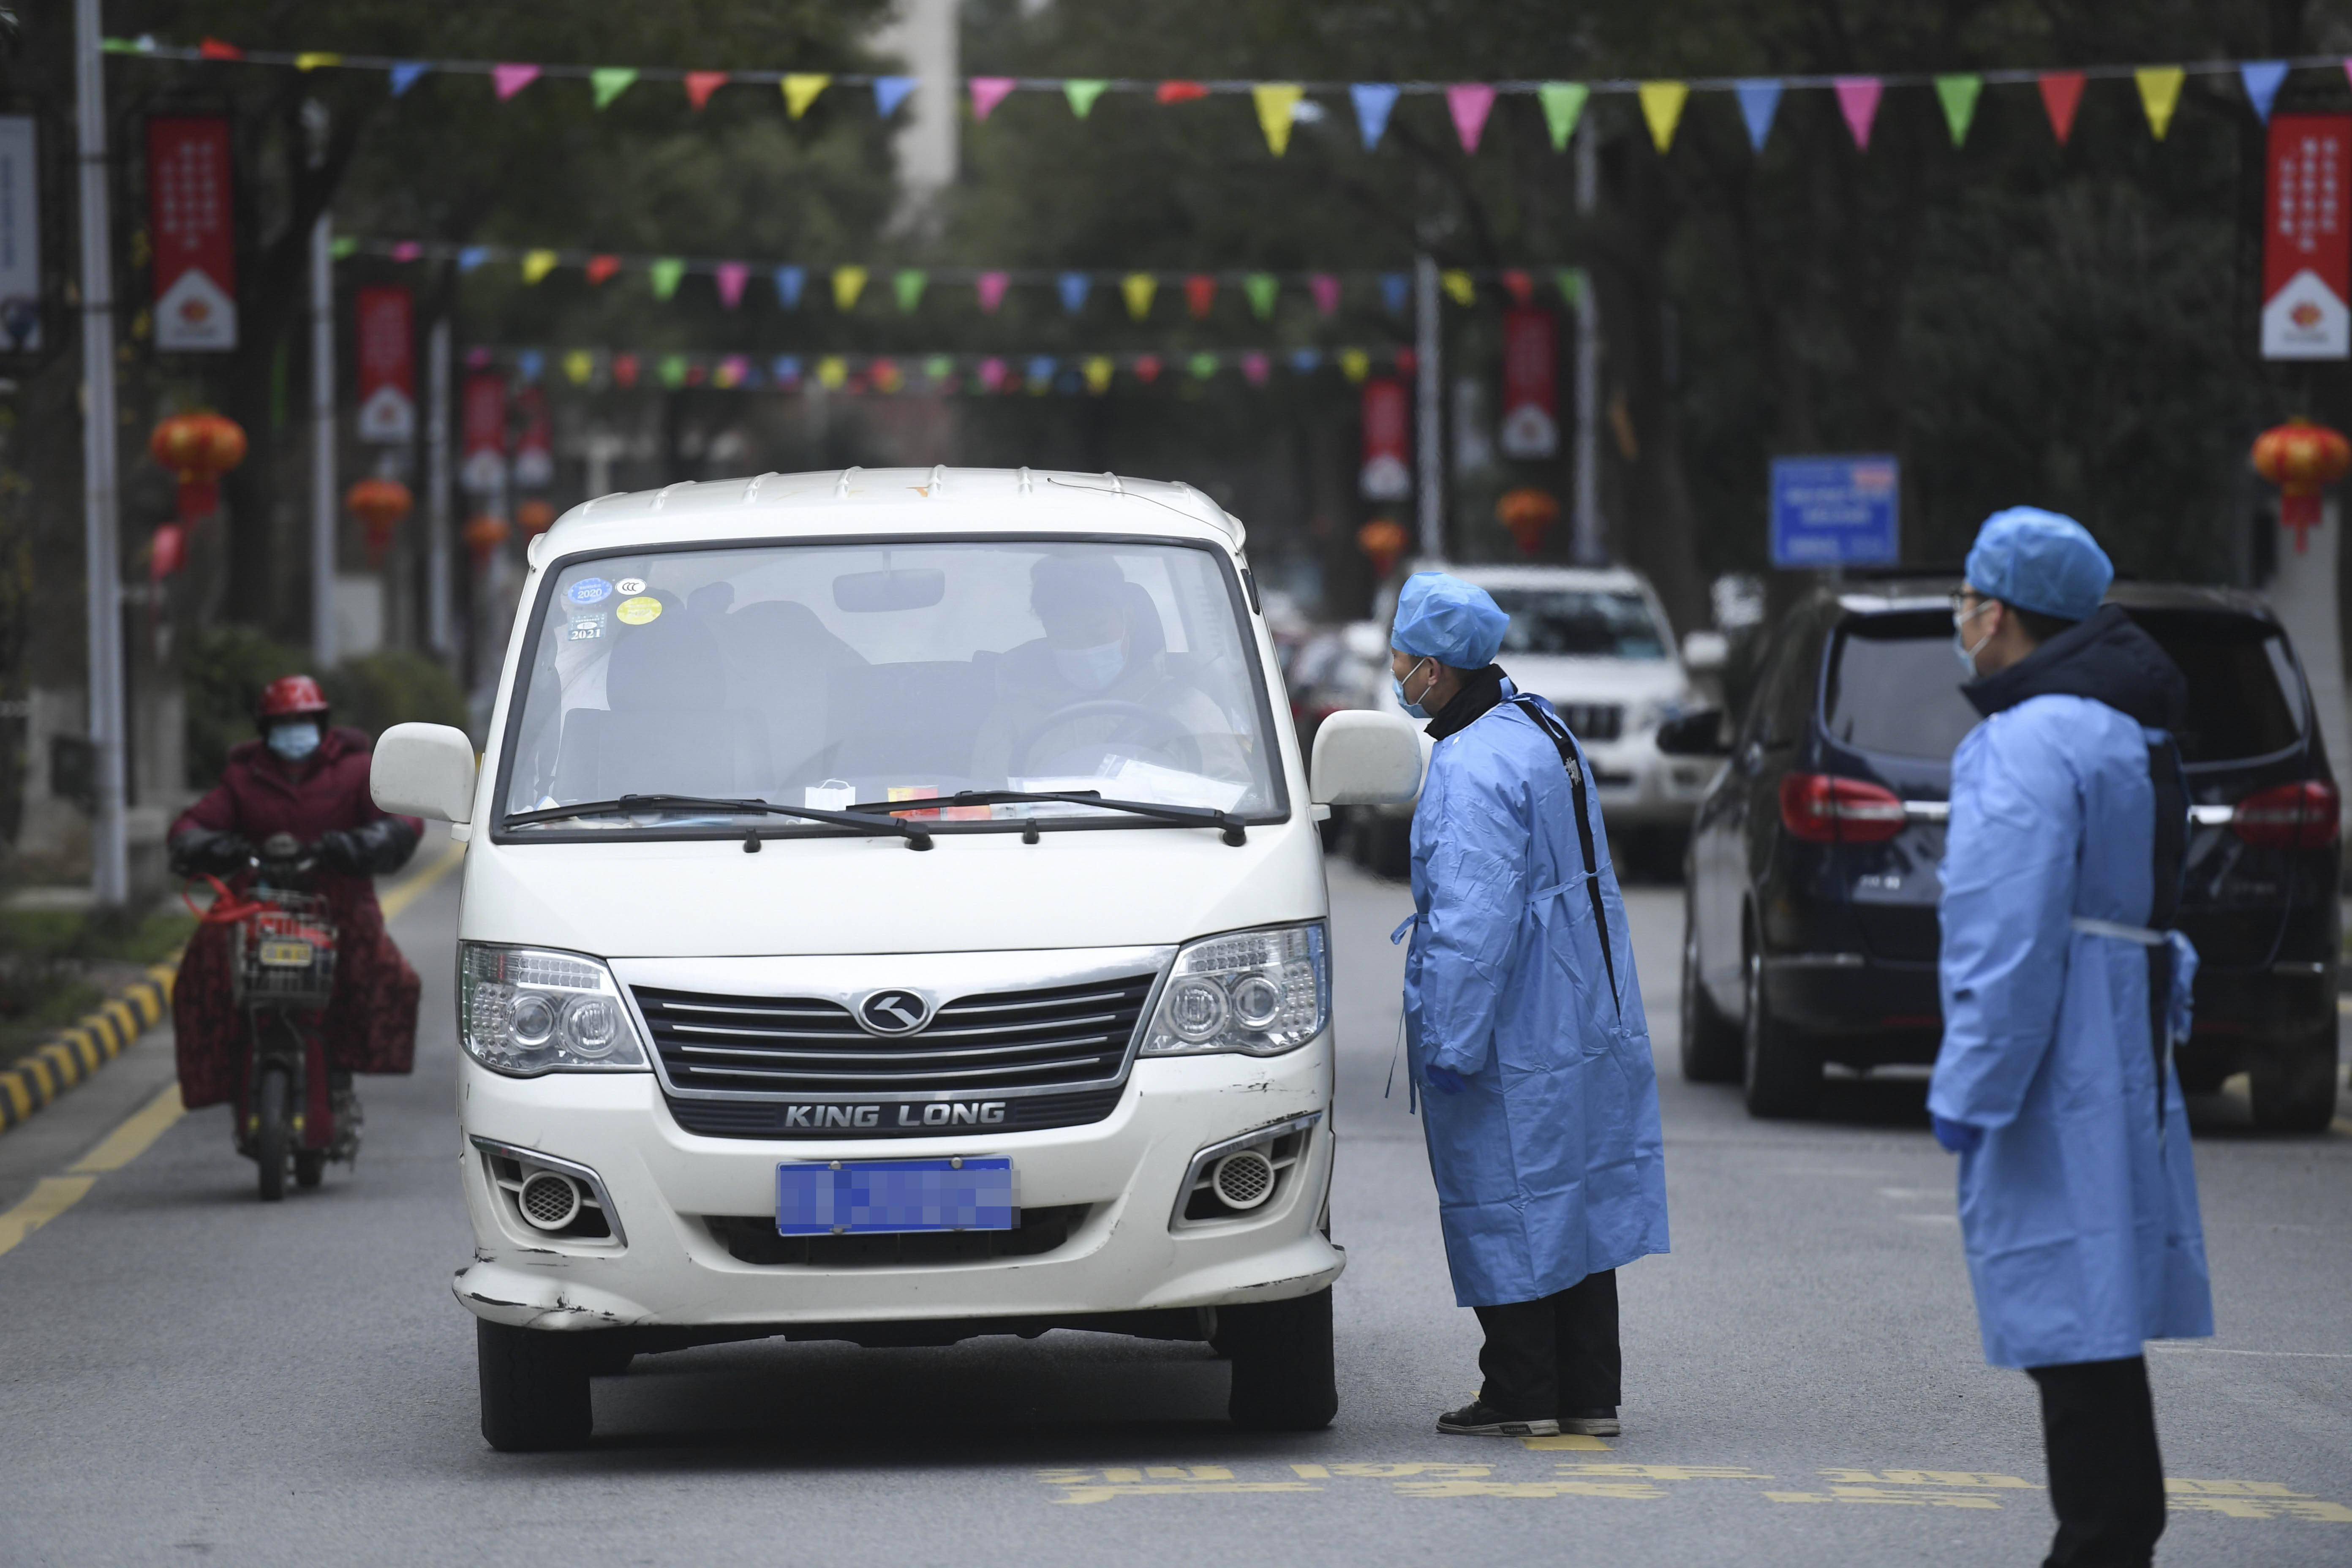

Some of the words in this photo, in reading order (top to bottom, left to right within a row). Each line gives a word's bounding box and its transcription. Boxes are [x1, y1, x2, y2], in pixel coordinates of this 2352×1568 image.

[577, 588, 602, 599] 2020
[571, 628, 600, 640] 2021
[785, 1105, 880, 1128] KING
[898, 1102, 1006, 1127] LONG
